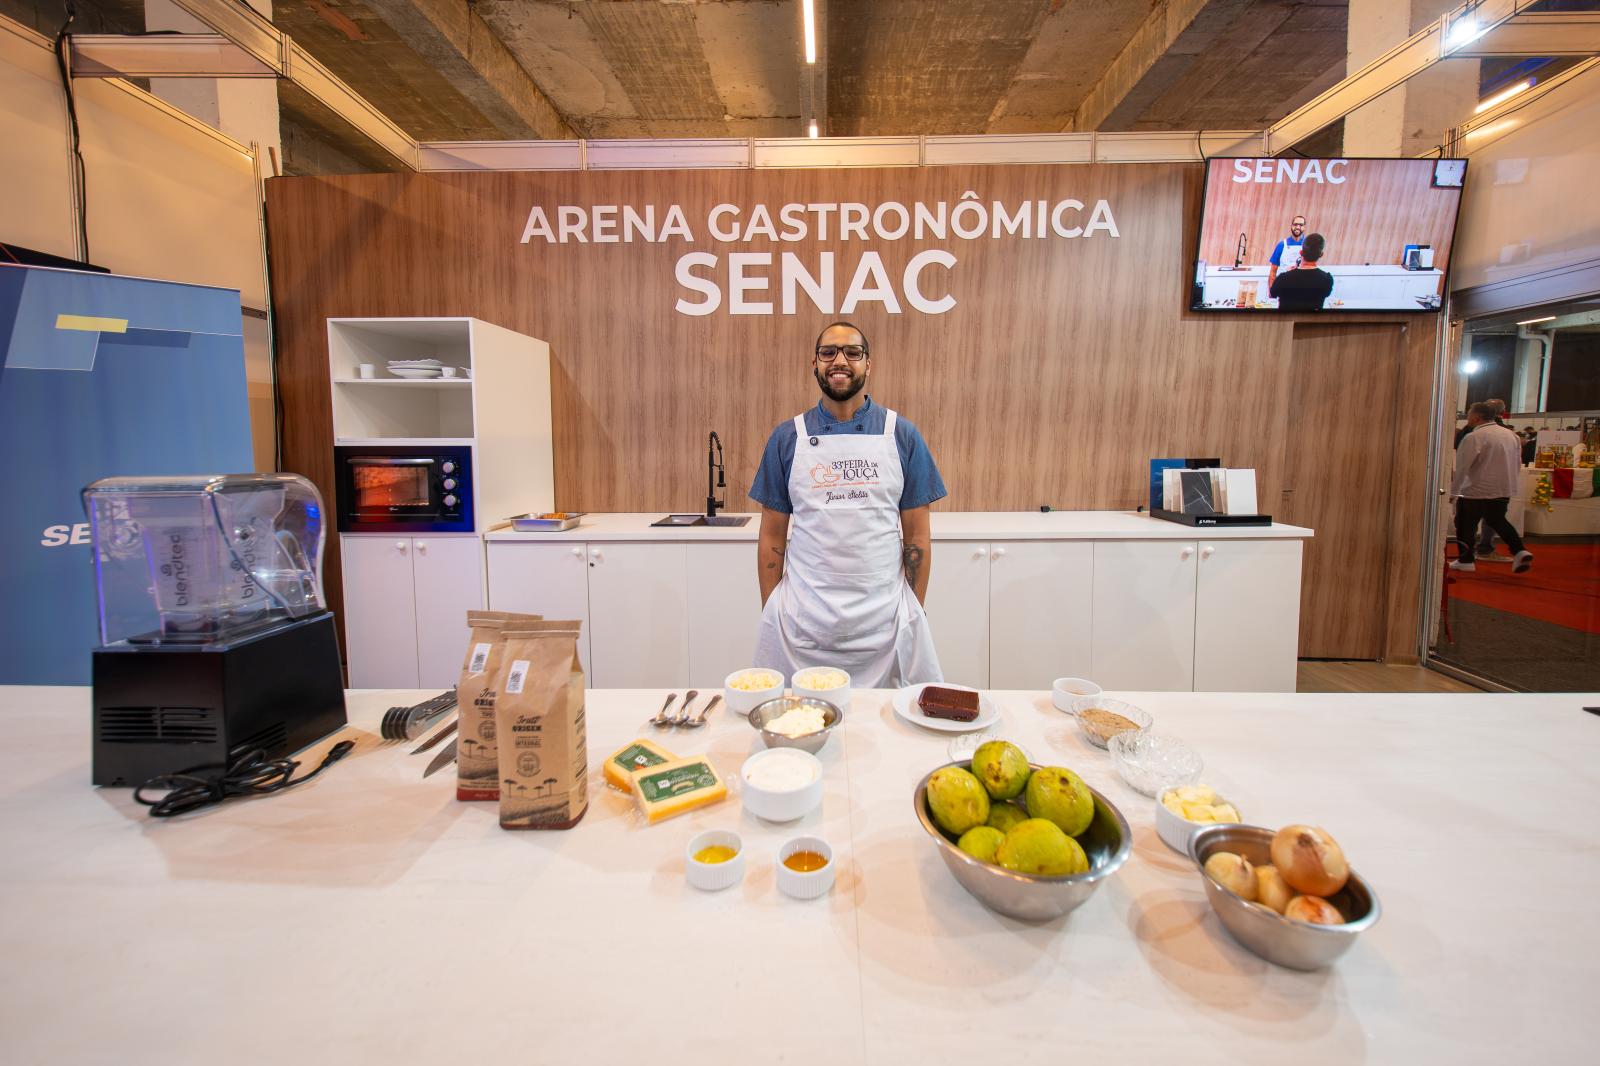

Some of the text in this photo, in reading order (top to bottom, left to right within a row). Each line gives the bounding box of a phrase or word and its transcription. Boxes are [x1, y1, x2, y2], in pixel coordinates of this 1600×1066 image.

[1232, 159, 1348, 184] SENAC
[520, 190, 1121, 243] ARENA GASTRONÔMICA
[674, 249, 958, 316] SENAC
[843, 468, 879, 480] LOUÇA
[844, 459, 870, 469] FEIRA
